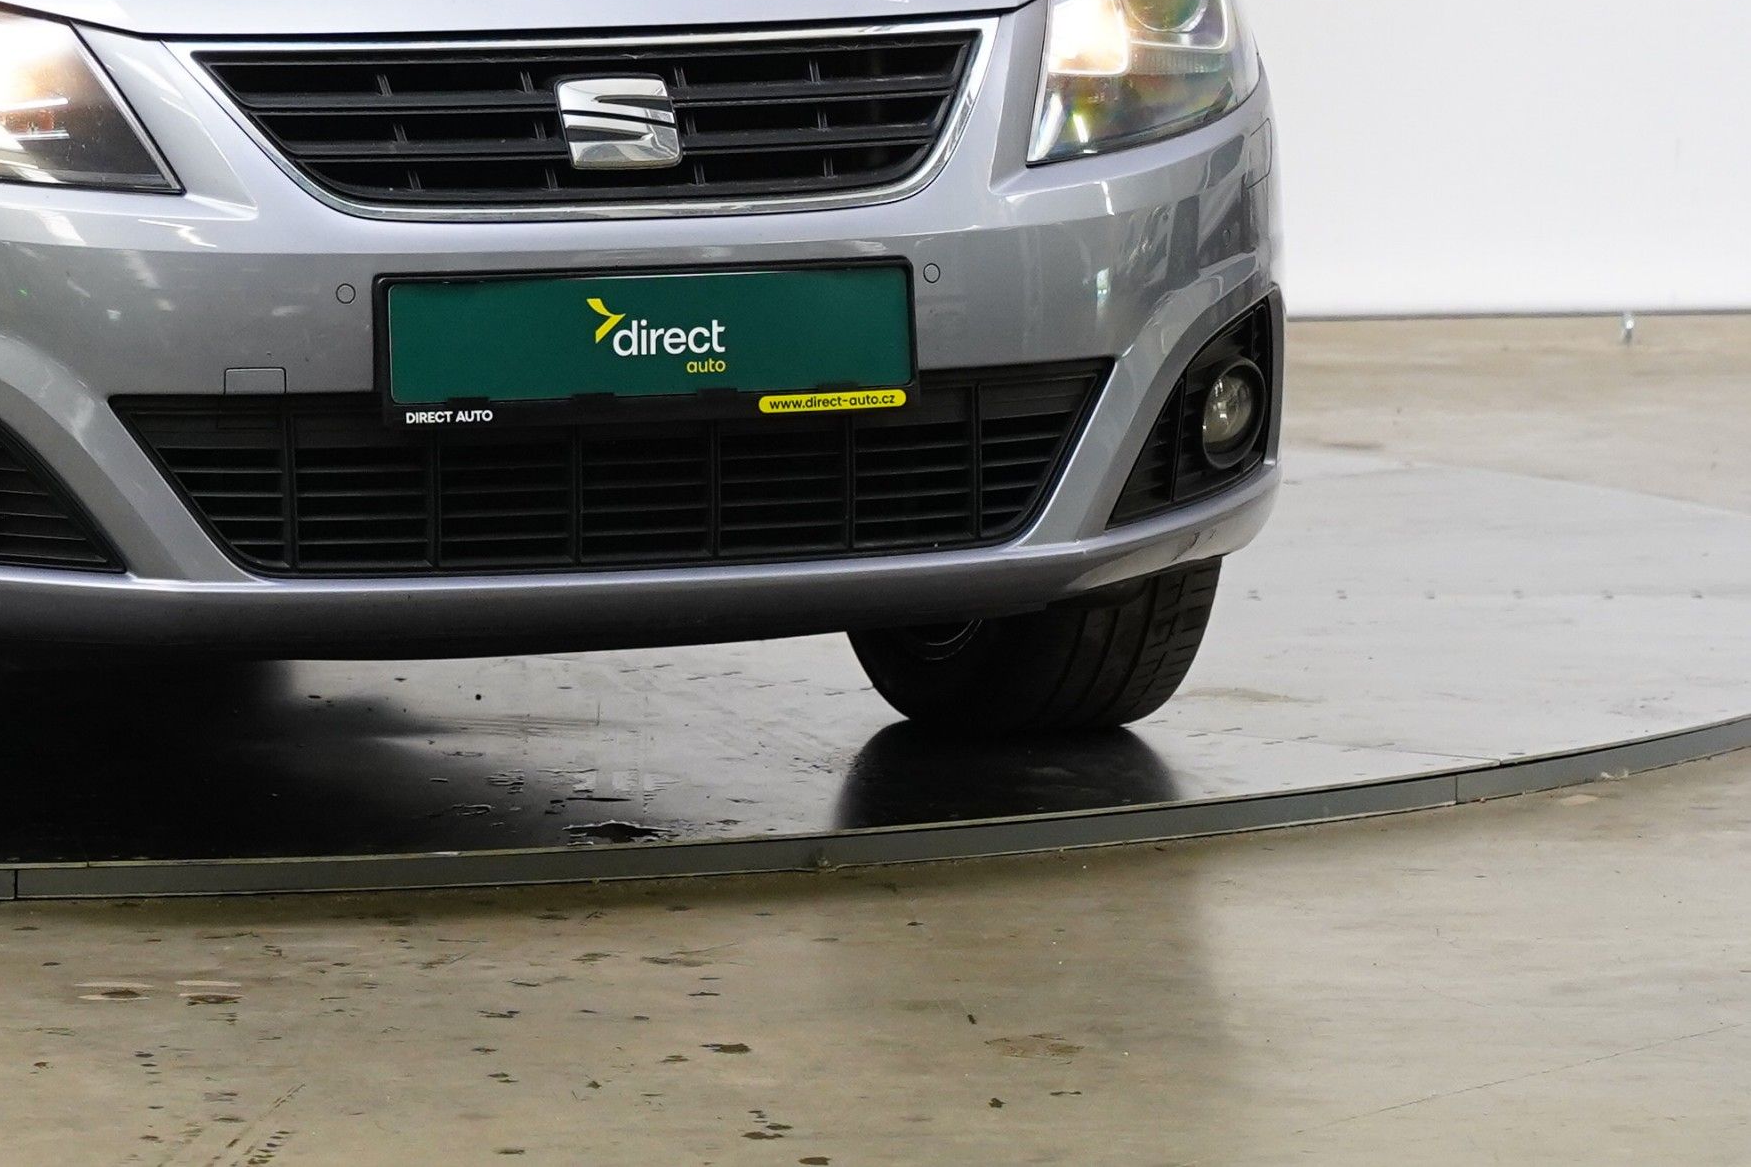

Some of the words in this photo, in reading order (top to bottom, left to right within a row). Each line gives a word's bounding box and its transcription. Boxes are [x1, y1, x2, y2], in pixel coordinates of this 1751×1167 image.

[612, 319, 726, 357] direct
[686, 357, 726, 373] auto
[769, 393, 896, 410] www.direct-auto.cz
[405, 410, 453, 425] DIRECT
[455, 409, 493, 423] AUTO
